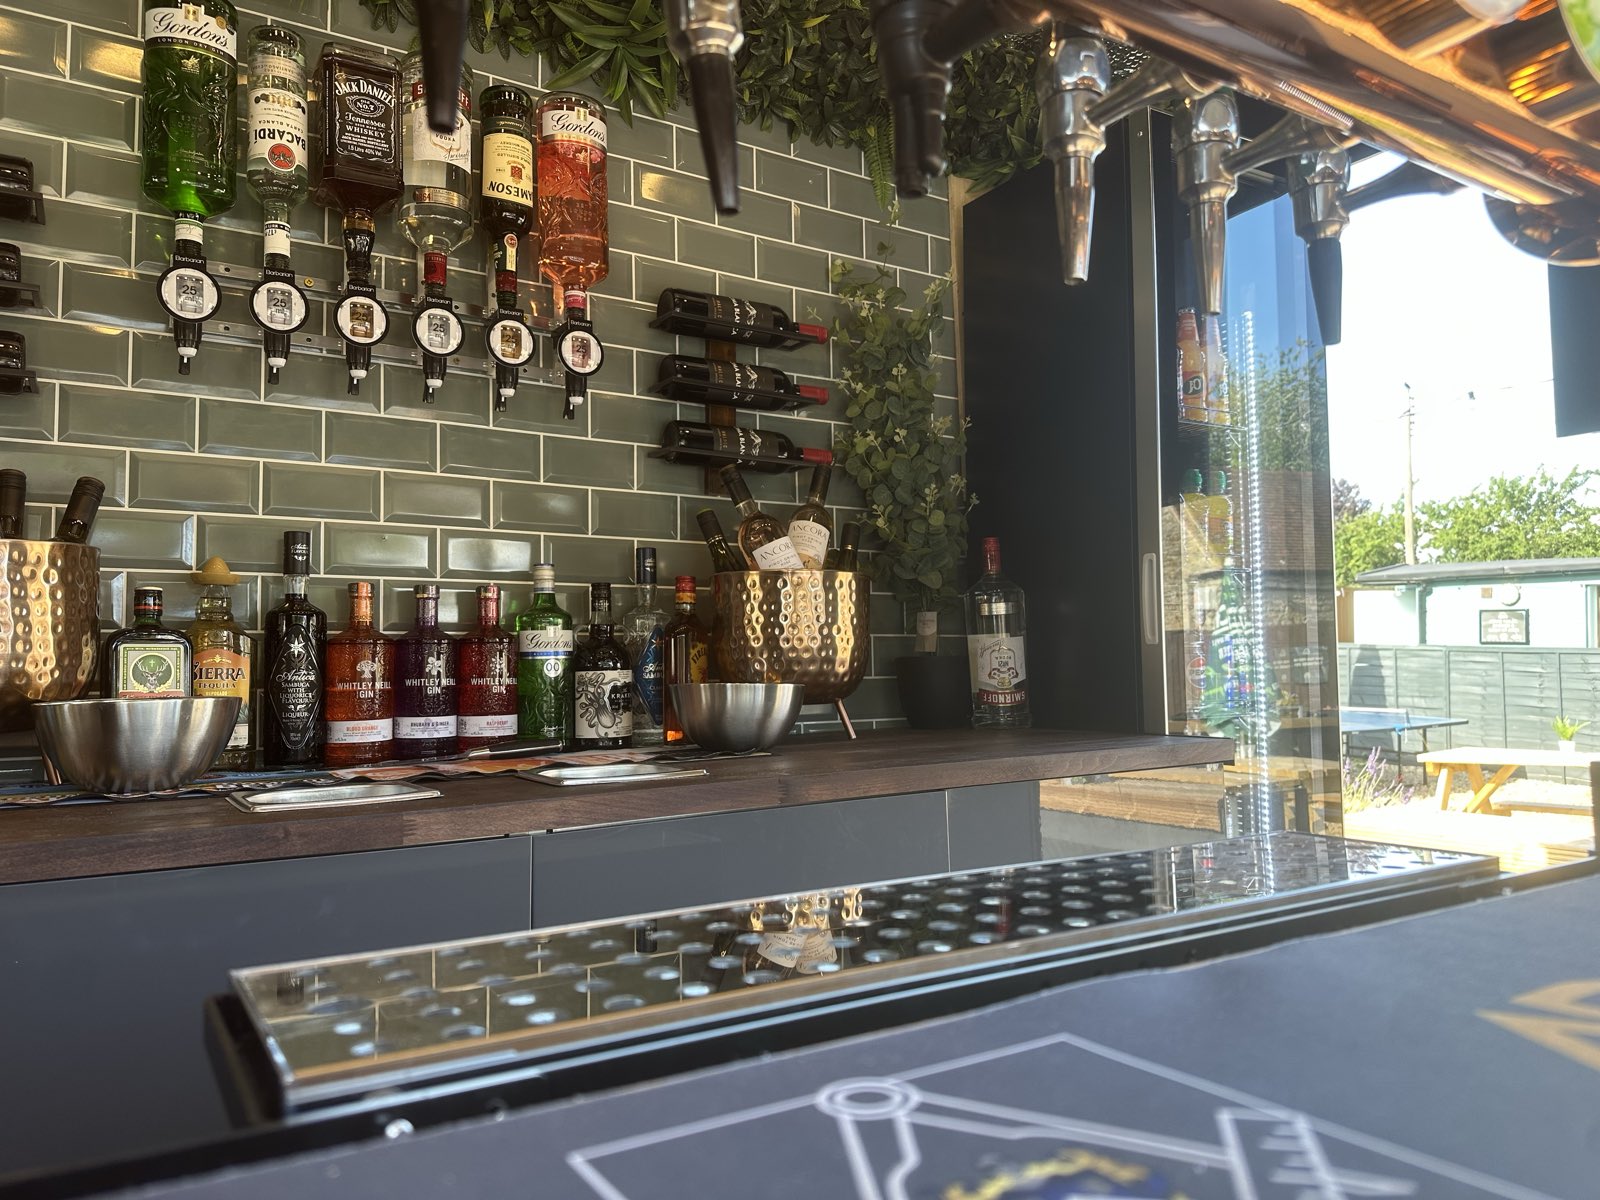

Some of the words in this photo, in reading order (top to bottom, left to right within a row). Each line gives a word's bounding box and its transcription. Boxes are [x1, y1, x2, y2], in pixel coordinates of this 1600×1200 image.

[153, 12, 228, 48] Gordon's
[157, 37, 189, 45] LONDON
[193, 41, 208, 49] DRY
[211, 47, 225, 56] GIN
[334, 81, 360, 96] JACK
[344, 112, 386, 129] Tennessee
[285, 122, 304, 134] CARTA
[345, 124, 386, 139] WHISKEY
[435, 133, 456, 142] VODKA
[487, 180, 533, 201] AMESON
[182, 284, 197, 296] 25
[272, 297, 287, 308] 25
[433, 323, 445, 333] 25
[576, 345, 587, 353] 25
[336, 681, 373, 690] WHITLEY
[374, 681, 392, 689] NEILL
[404, 678, 440, 687] WHITLEY
[441, 678, 457, 686] NEILL
[470, 677, 504, 686] WHITLEY
[505, 677, 518, 685] NEILL
[359, 690, 374, 698] GIN
[426, 686, 441, 694] GIN
[492, 685, 506, 693] GIN
[983, 690, 1025, 703] SMIRNOFF
